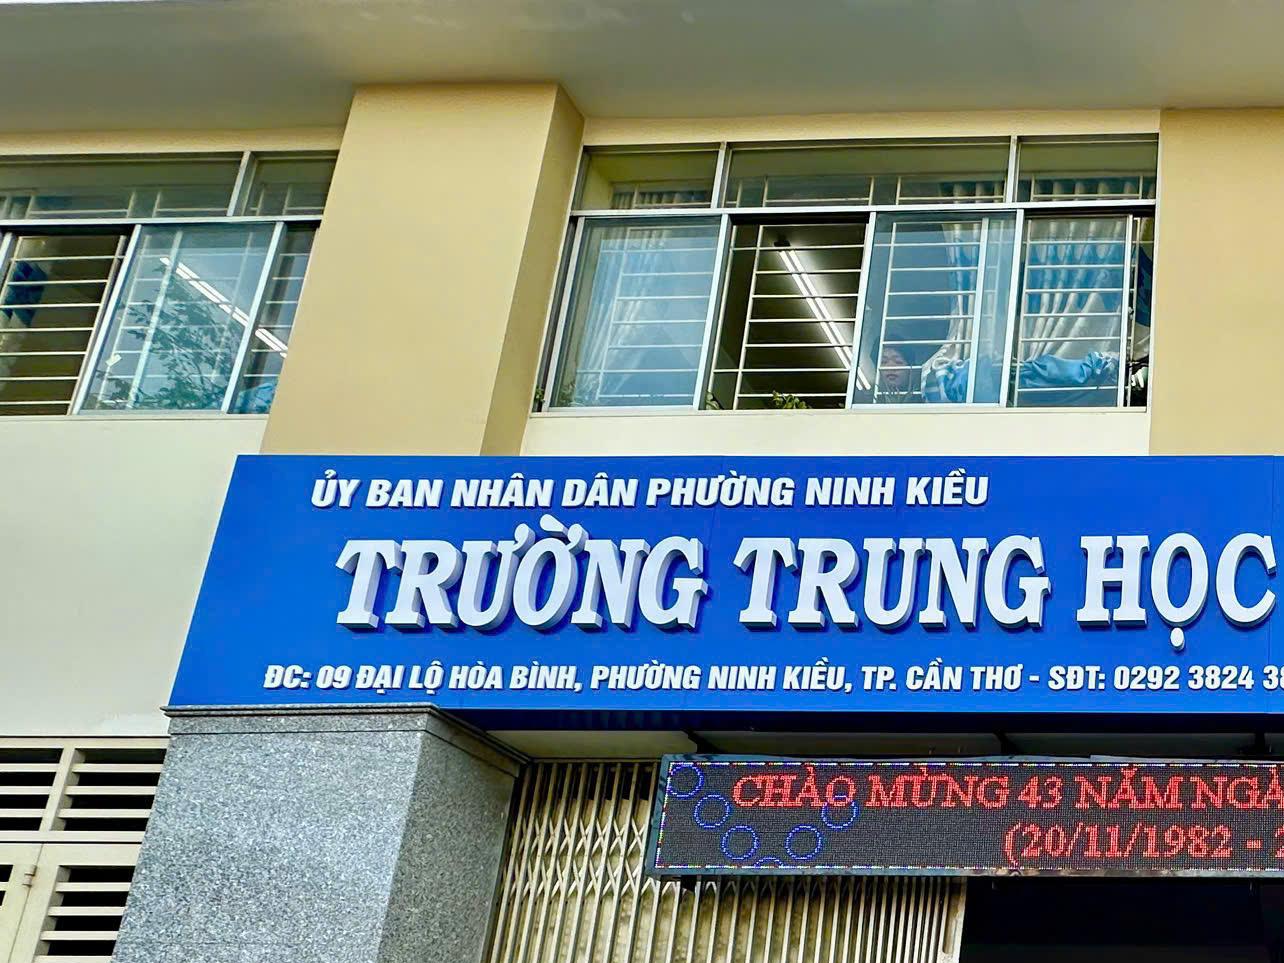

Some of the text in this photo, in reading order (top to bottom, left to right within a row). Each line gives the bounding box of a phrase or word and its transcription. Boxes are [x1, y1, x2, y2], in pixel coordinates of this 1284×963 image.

[311, 467, 989, 508] ỦY BAN NHÂN DÂN PHƯỜNG NINH KIỀU
[336, 513, 708, 629] TRƯỜNG
[727, 533, 1051, 628] TRUNG
[1076, 532, 1277, 651] HỌC
[263, 664, 311, 690] ĐC:
[315, 664, 352, 690] 09
[355, 665, 405, 695] ĐẠI
[409, 661, 444, 695] LỘ
[448, 660, 503, 690] HÒA
[508, 661, 583, 692] BÌNH,
[590, 659, 702, 691] PHƯỜNG
[708, 665, 777, 691] NINH
[782, 656, 853, 693] KIỀU,
[861, 665, 897, 691] TP.
[906, 657, 963, 691] CẦN
[970, 663, 1024, 691] THƠ
[1048, 665, 1106, 691] SĐT:
[1113, 665, 1181, 691] 0292
[1187, 665, 1255, 691] 3824
[732, 766, 857, 808] CHÀO
[1018, 775, 1063, 809] 43
[1074, 767, 1184, 810] NĂM
[1003, 821, 1232, 868] (20/11/1982
